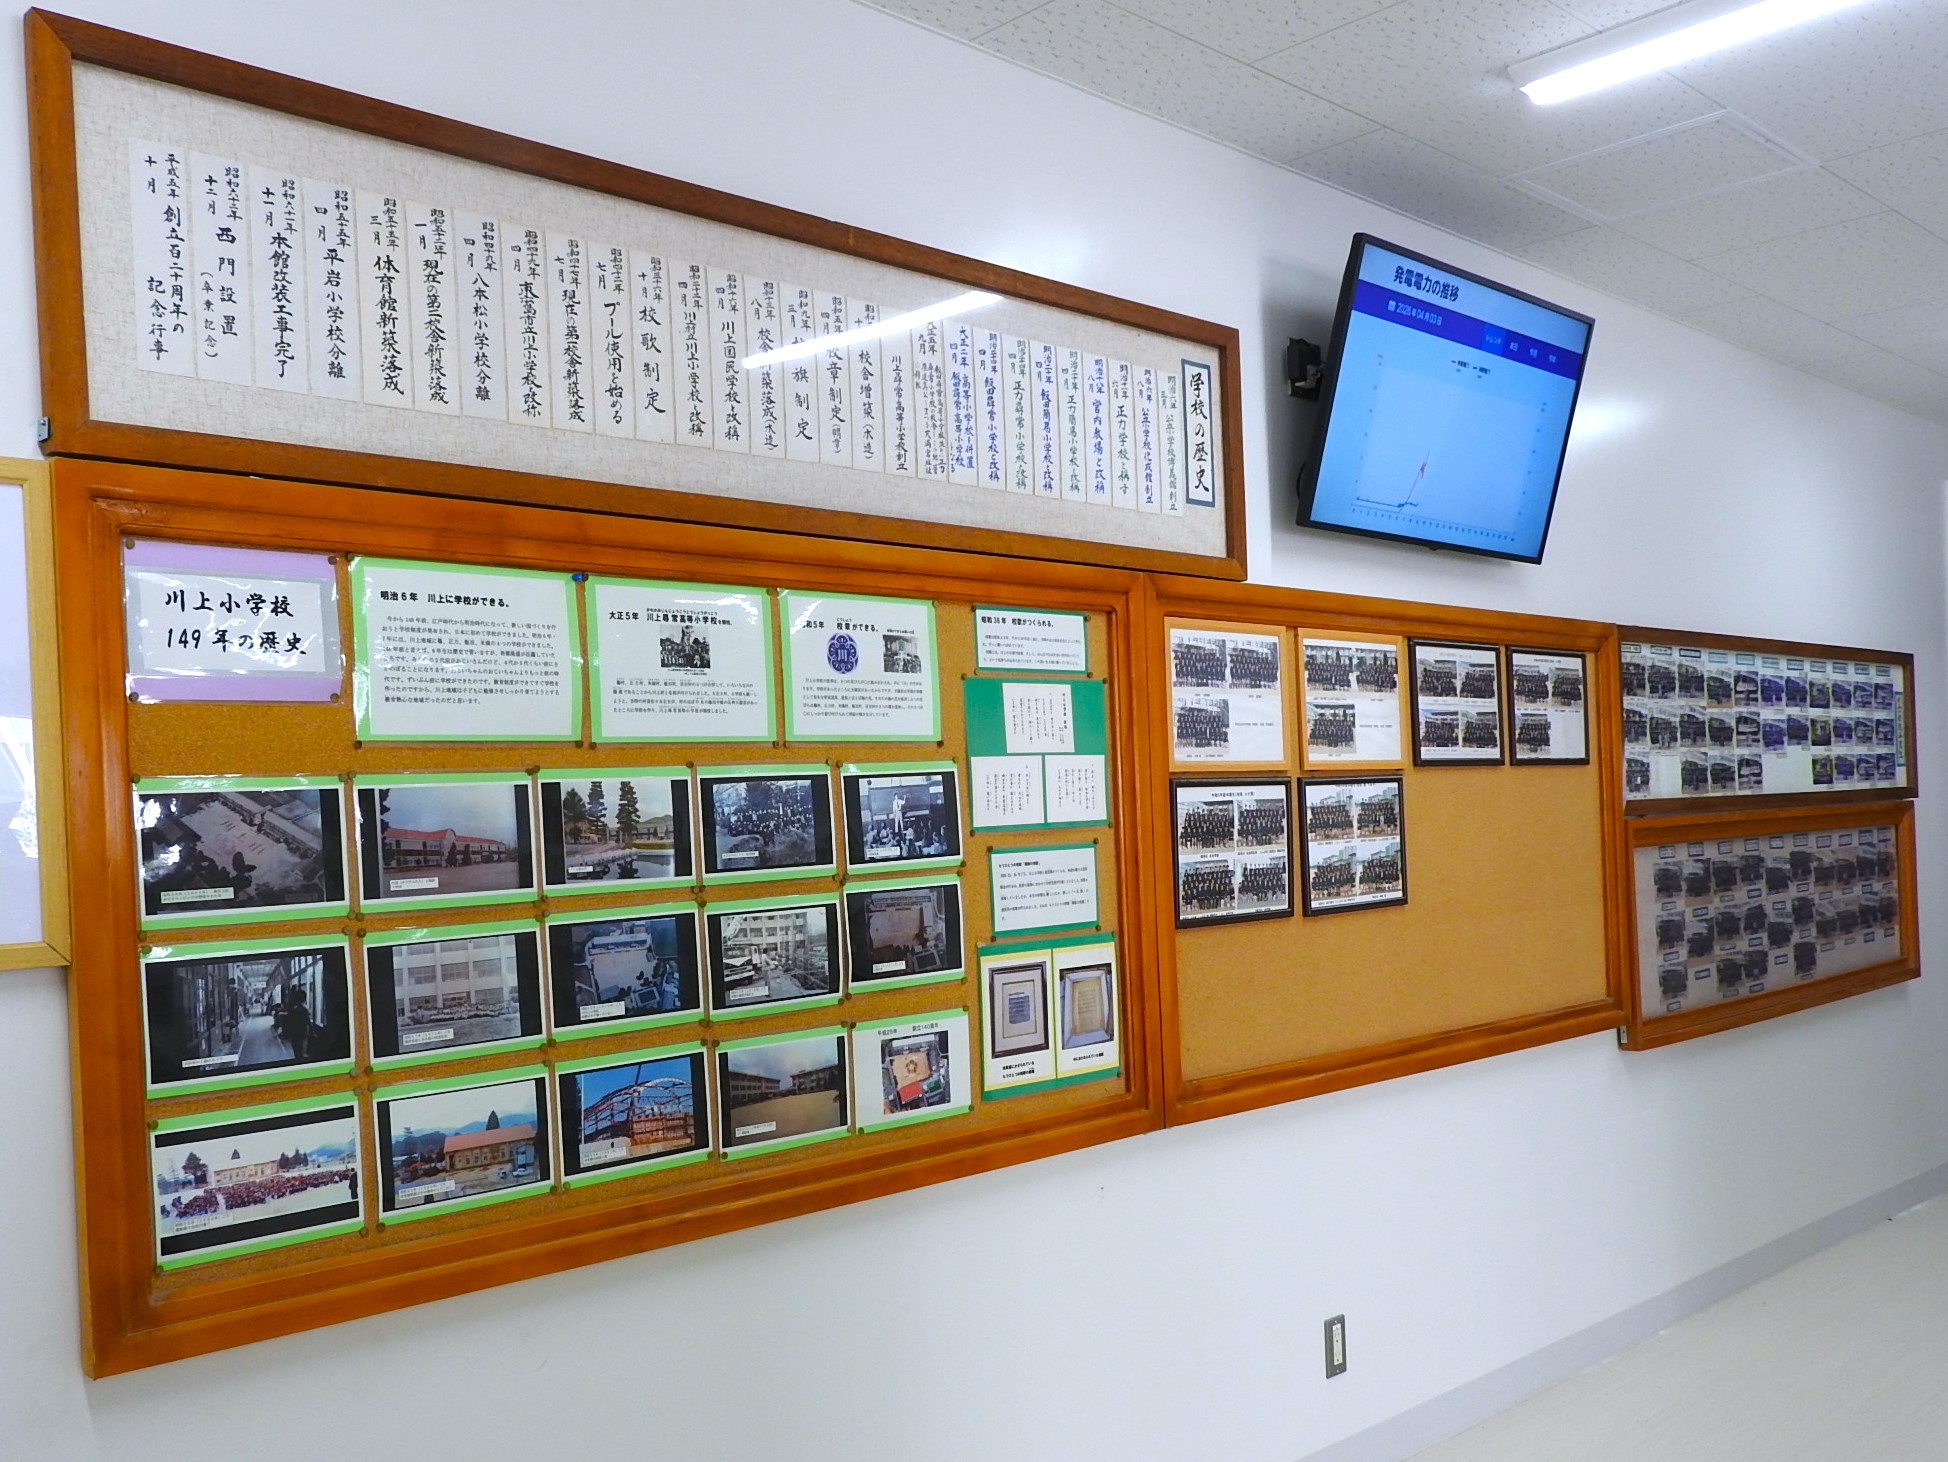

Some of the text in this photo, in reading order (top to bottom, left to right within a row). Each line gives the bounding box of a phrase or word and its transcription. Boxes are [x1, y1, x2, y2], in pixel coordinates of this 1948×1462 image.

[165, 154, 180, 199] 平成五年
[205, 175, 218, 215] 十二月
[262, 187, 275, 227] 十一月
[314, 207, 329, 242] 四月
[370, 216, 382, 246] 三月
[463, 238, 476, 268] 四月
[511, 245, 521, 272] 四月
[216, 227, 238, 336] 西門設置
[554, 256, 565, 283] 七月
[596, 262, 607, 290] 七月
[1394, 265, 1460, 302] 発電電力の推移
[638, 272, 648, 299] 十月
[678, 282, 688, 307] 四月
[715, 287, 725, 310] 四月
[147, 277, 168, 361] 記念行事
[269, 232, 295, 378] 本館改装工事完了
[323, 248, 346, 379] 平岩小学校分離
[750, 298, 762, 320] 八月
[787, 304, 797, 328] 三月
[798, 290, 811, 332] 昭和九年
[373, 255, 404, 395] 体育館新築落成
[472, 273, 491, 401] 八本松小学校分離
[821, 312, 830, 335] 四月
[918, 334, 927, 355] 九月
[949, 342, 958, 364] 四月
[959, 326, 969, 368] 大正二年
[639, 305, 666, 414] 校歌制定
[978, 349, 986, 371] 四月
[1008, 353, 1016, 374] 四月
[1035, 361, 1043, 382] 四月
[1062, 368, 1069, 391] 四月
[1190, 372, 1210, 493] 学校の歴史
[165, 589, 294, 617] 川上小学校
[380, 591, 510, 608] 明治6年 川上に学校ができる。
[609, 612, 640, 621] 大正5年
[801, 621, 825, 629] 和5年
[837, 622, 879, 632] 校章ができる。
